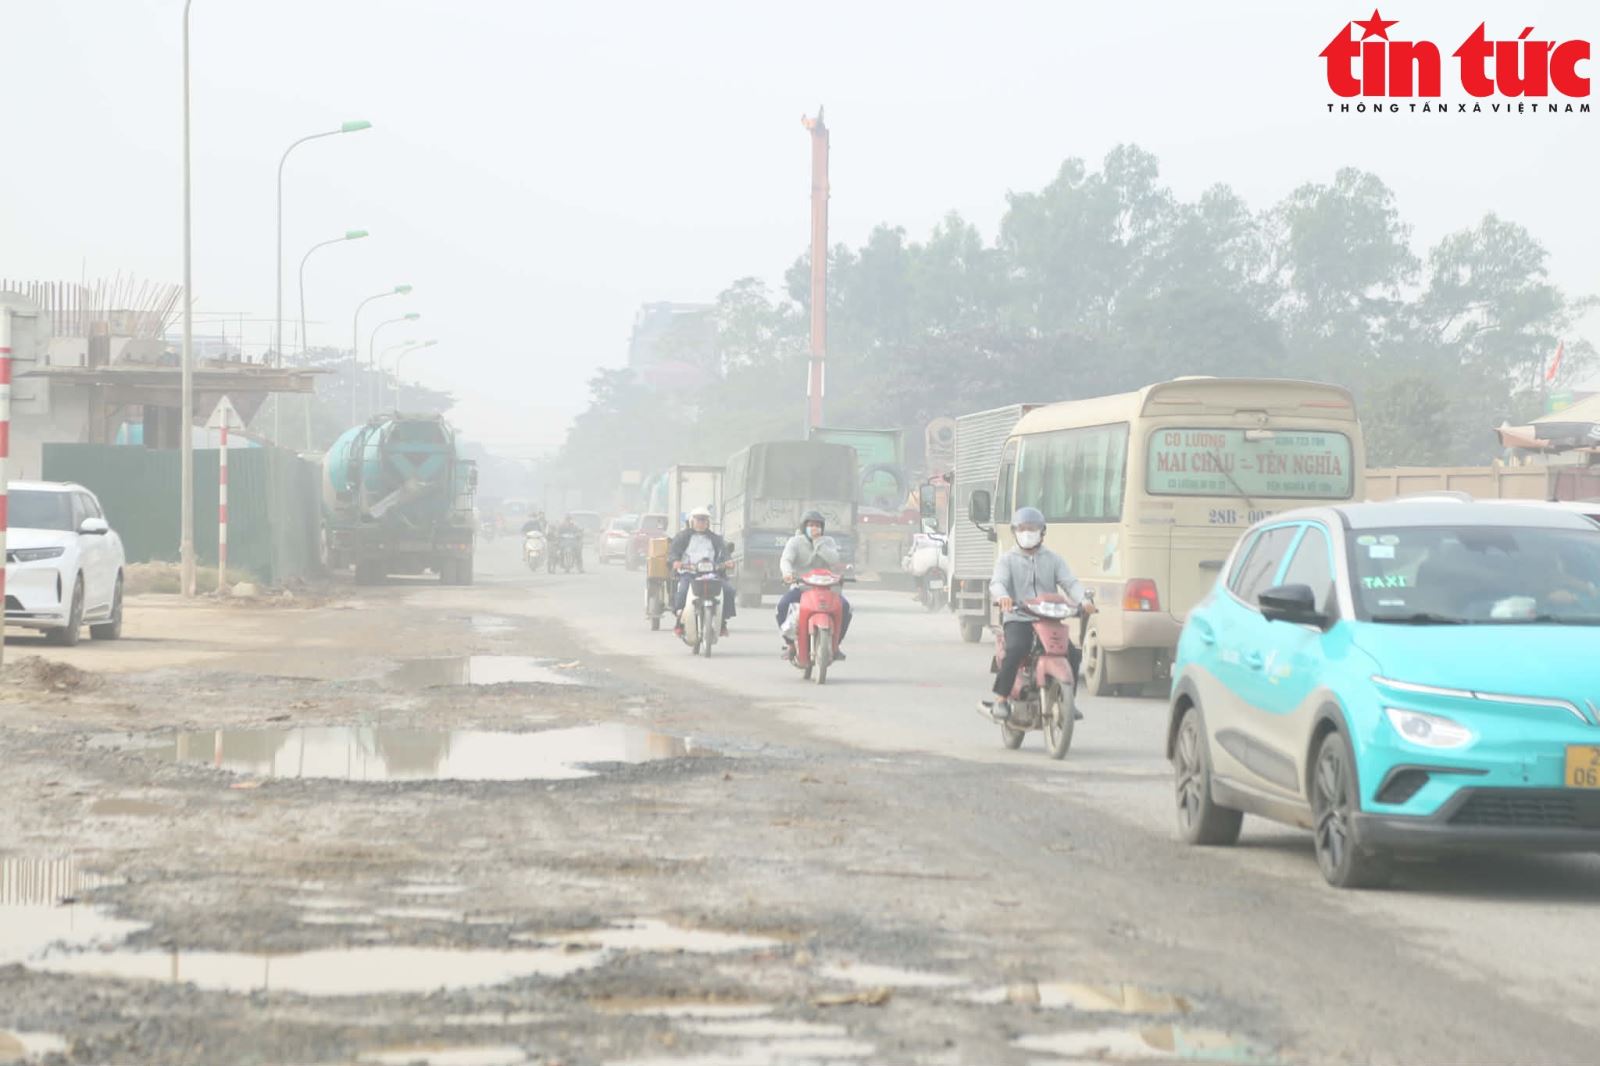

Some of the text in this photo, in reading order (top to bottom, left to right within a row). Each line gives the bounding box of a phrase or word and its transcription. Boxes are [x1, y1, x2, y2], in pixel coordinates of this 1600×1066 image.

[1157, 451, 1187, 472] MAI
[1191, 448, 1235, 473] CHÂU
[1256, 449, 1287, 474] YÊN
[1293, 450, 1343, 476] NGHĨA
[1362, 575, 1407, 590] TAXI
